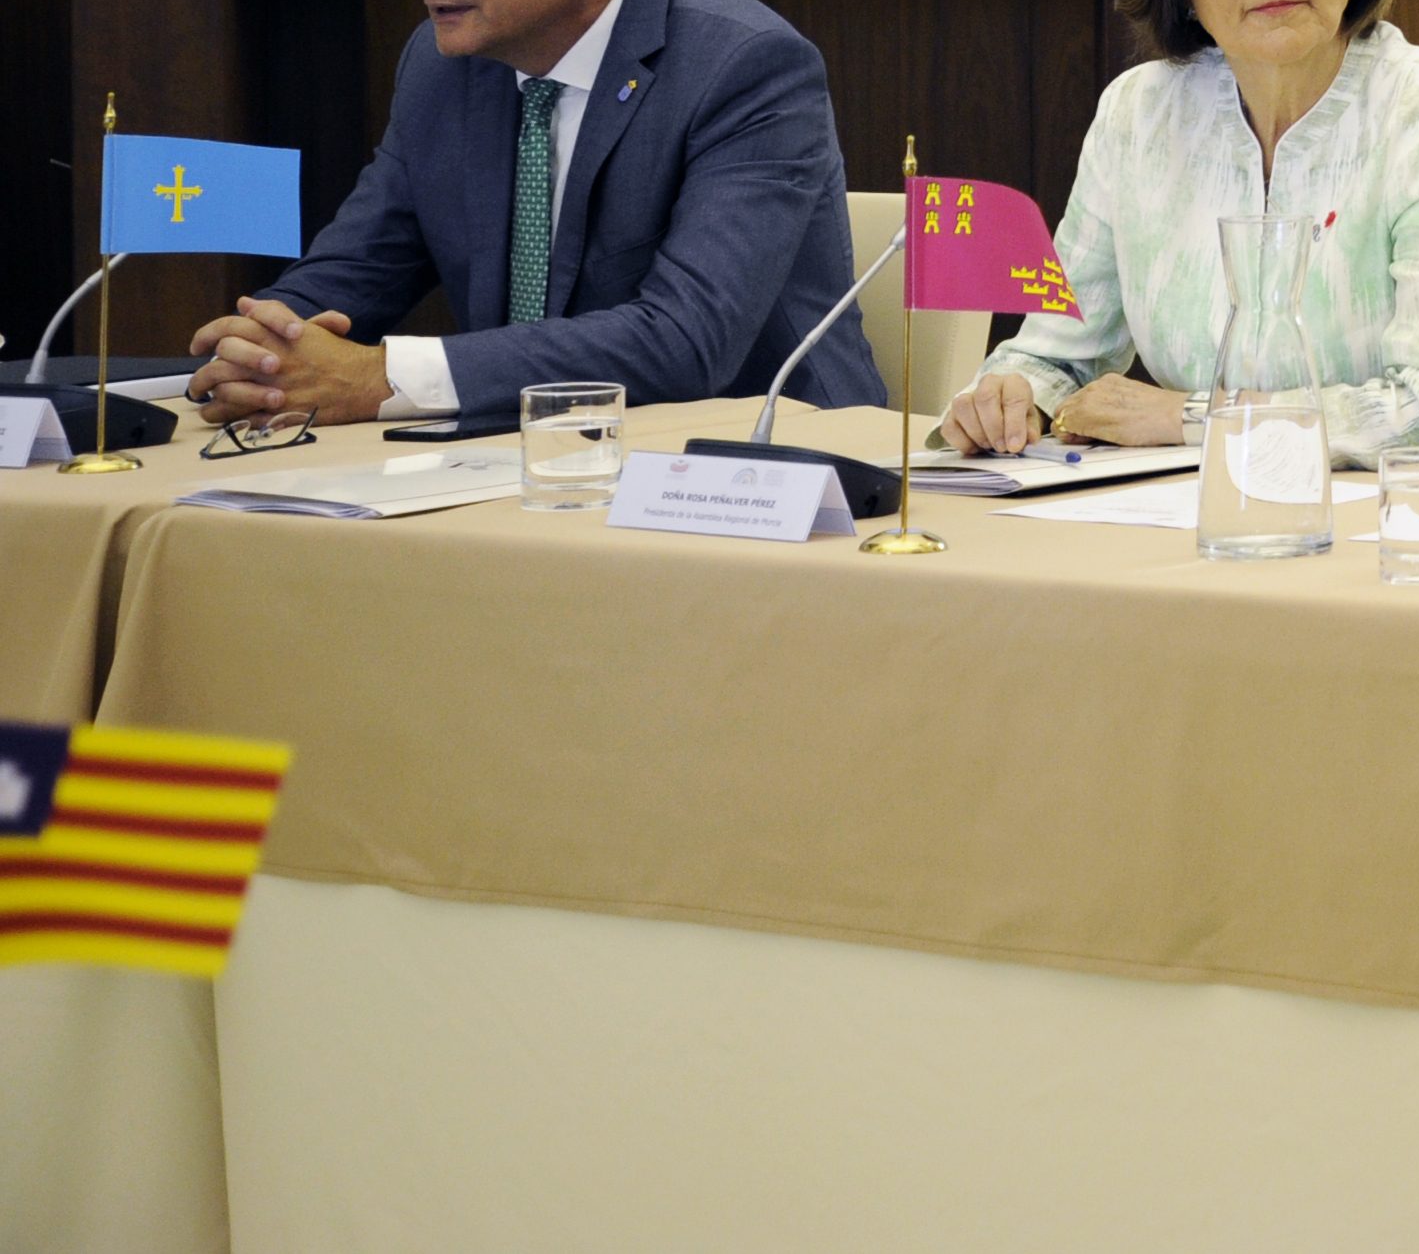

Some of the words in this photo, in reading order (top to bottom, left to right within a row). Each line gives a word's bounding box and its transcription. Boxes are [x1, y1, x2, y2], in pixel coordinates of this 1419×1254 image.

[661, 490, 684, 501] DOÑA
[686, 493, 707, 503] ROSA
[709, 493, 749, 507] PEÑALVER
[750, 497, 777, 509] PÉREZ
[643, 507, 675, 518] Presidenta
[676, 511, 685, 519] de
[693, 512, 722, 522] Asamblea
[723, 514, 750, 525] Regional
[750, 516, 759, 525] de
